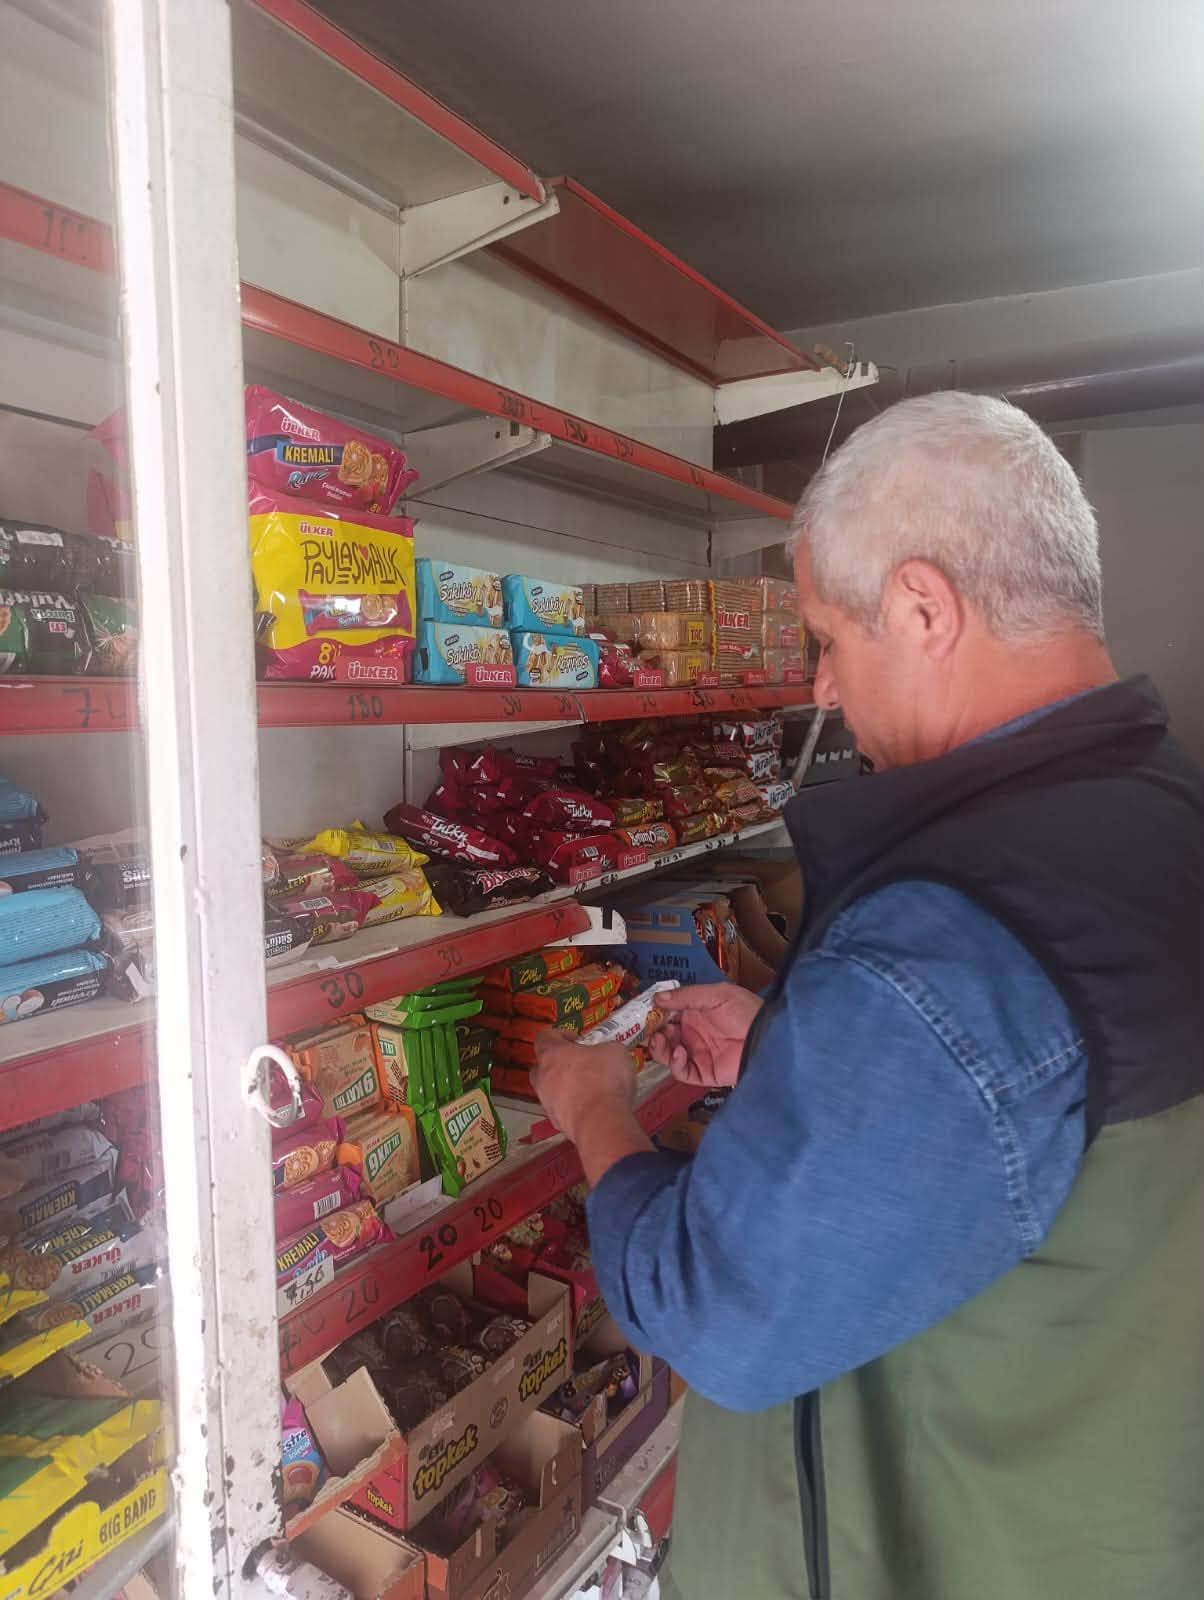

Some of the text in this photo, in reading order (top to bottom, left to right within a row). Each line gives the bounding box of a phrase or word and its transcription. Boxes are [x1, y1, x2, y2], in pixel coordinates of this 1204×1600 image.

[285, 446, 334, 464] KREMALI
[299, 522, 334, 537] ÜLKER
[718, 607, 751, 630] ÜLKER
[348, 660, 399, 681] ÜLKER
[476, 666, 513, 683] ÜLKER
[320, 971, 364, 1009] 30
[615, 1023, 641, 1042] ÜLKER
[420, 1198, 504, 1269] 20 20
[72, 1247, 121, 1274] ÜLKER
[277, 1232, 320, 1271] KREMALI
[81, 1272, 136, 1312] KREMALI
[518, 1338, 567, 1402] topkek
[413, 1424, 479, 1500] topkek
[99, 1514, 121, 1545] BIG
[123, 1489, 157, 1528] BANG
